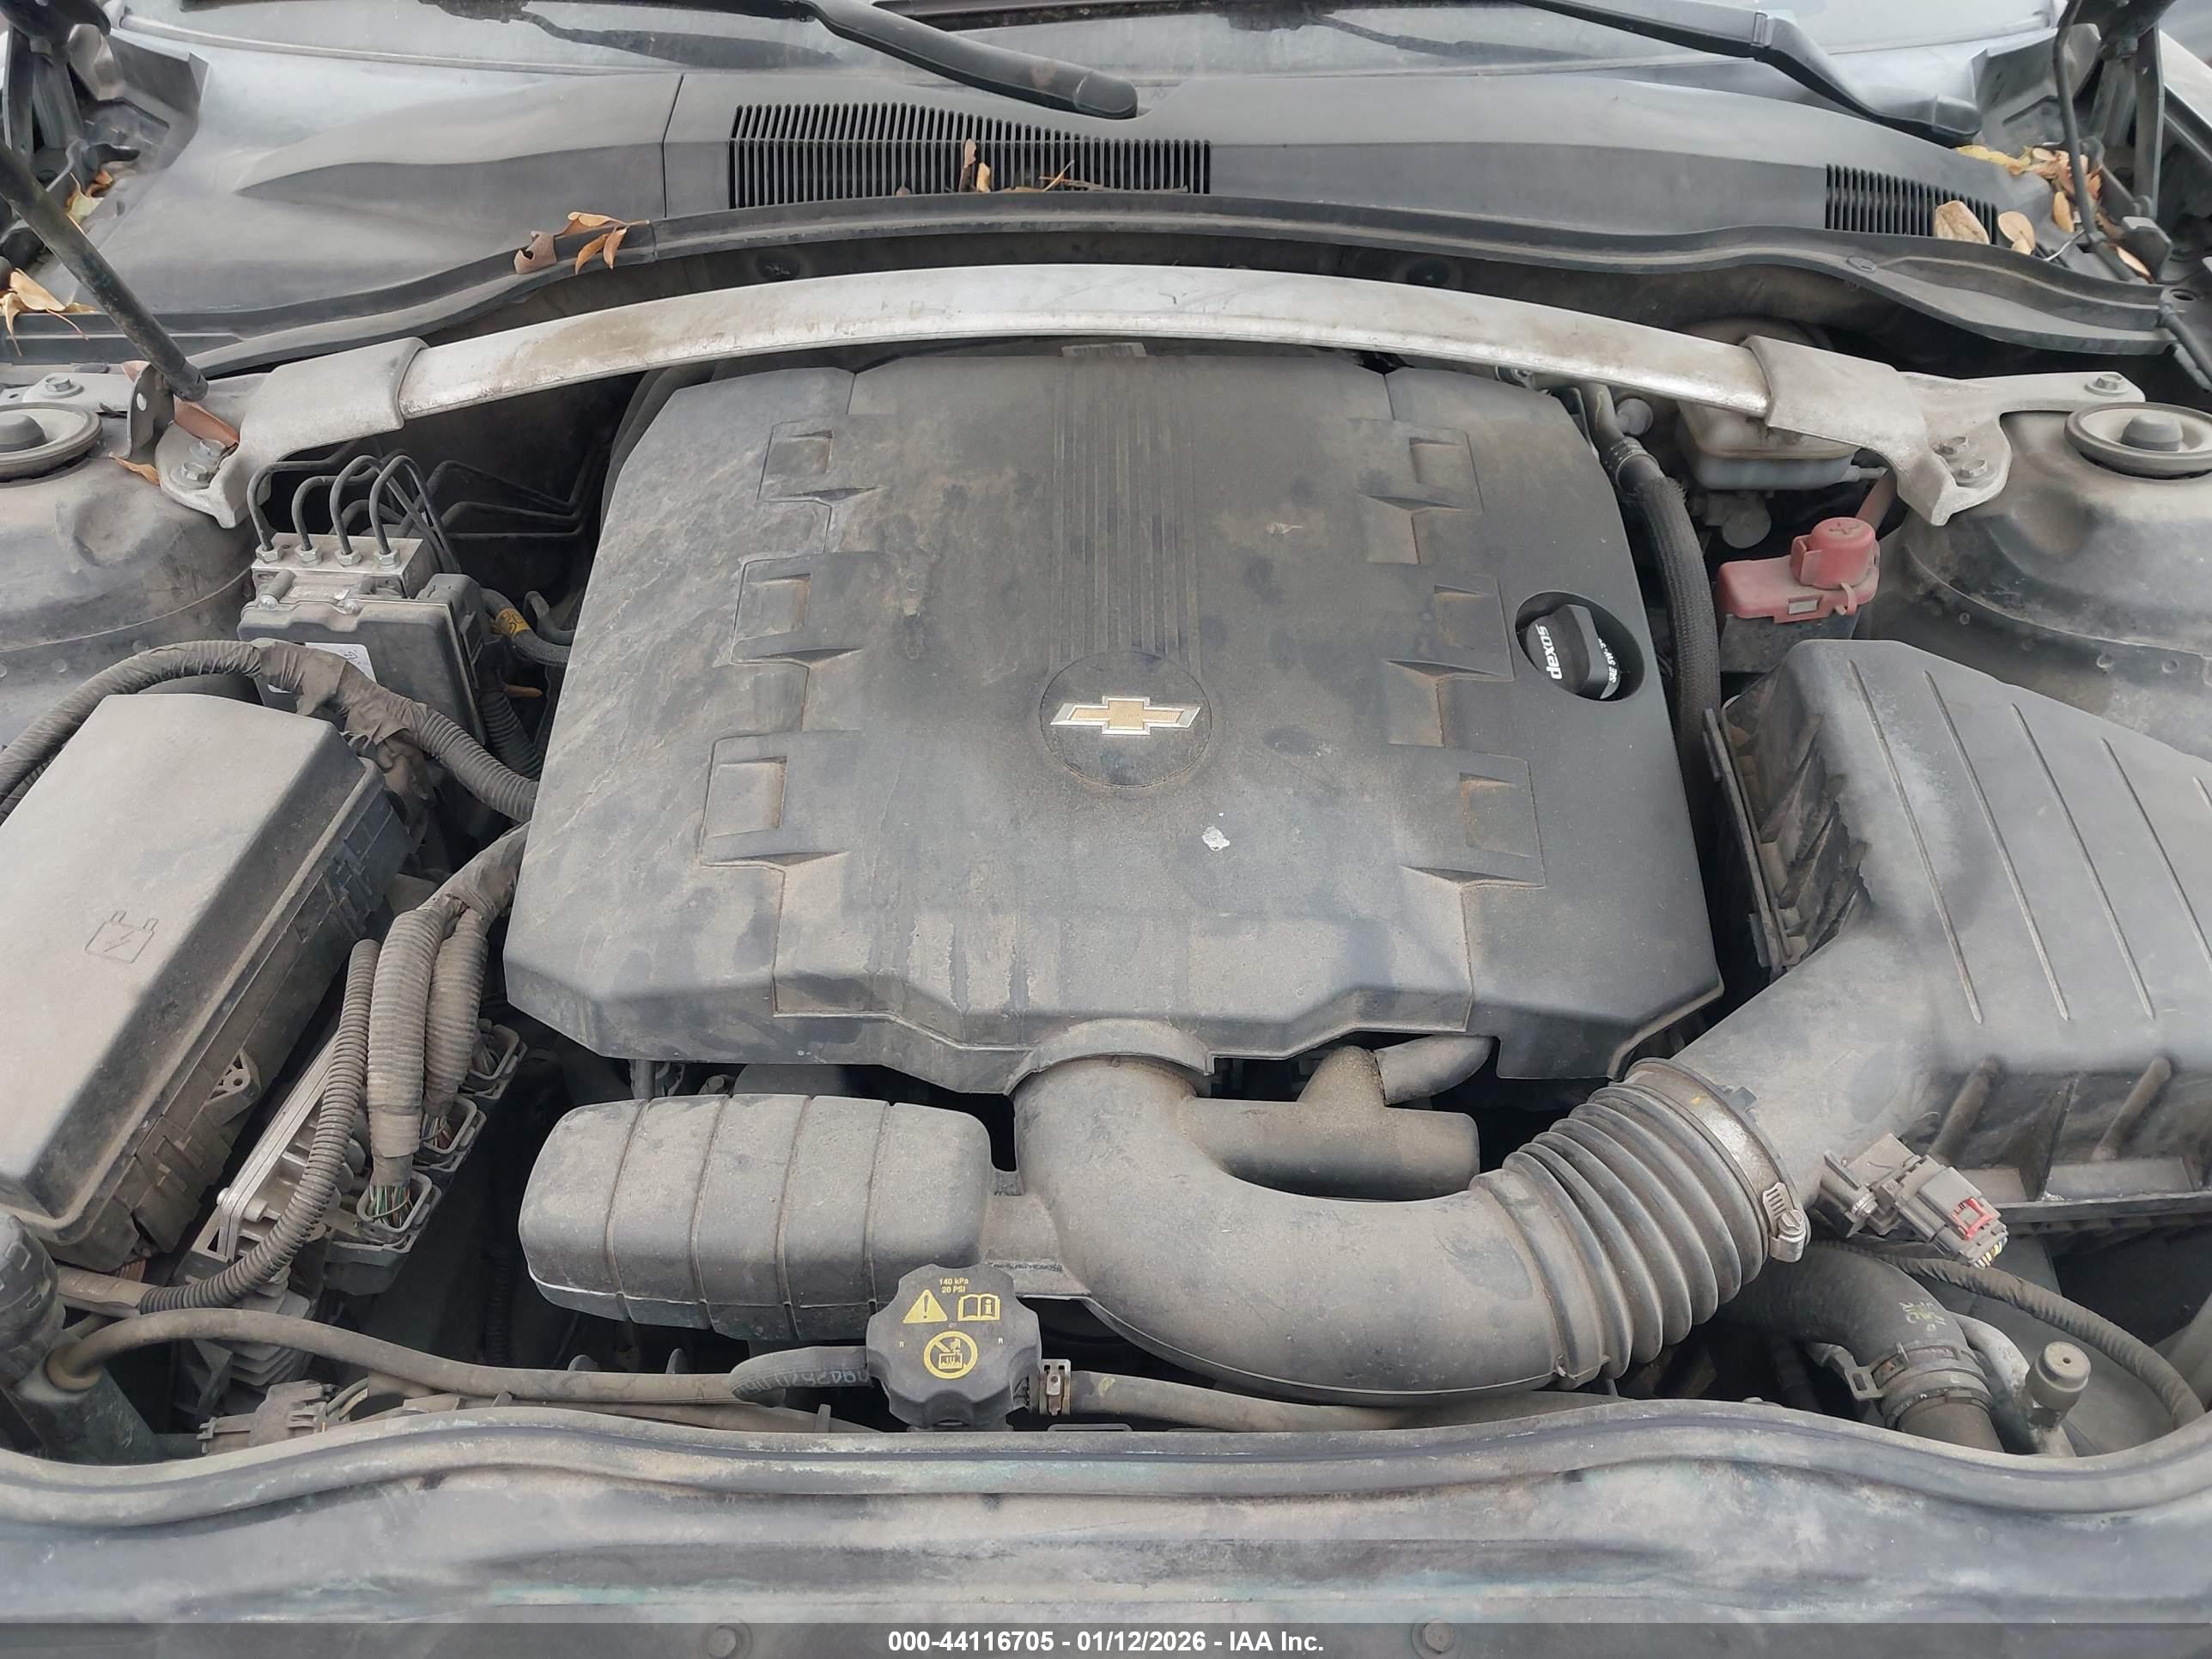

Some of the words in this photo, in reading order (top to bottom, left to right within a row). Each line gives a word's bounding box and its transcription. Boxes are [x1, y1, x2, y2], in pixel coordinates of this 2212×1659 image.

[1534, 623, 1563, 680] dexos
[1608, 666, 1618, 684] SAE
[954, 1277, 969, 1285] kPa
[953, 1285, 966, 1293] PSI
